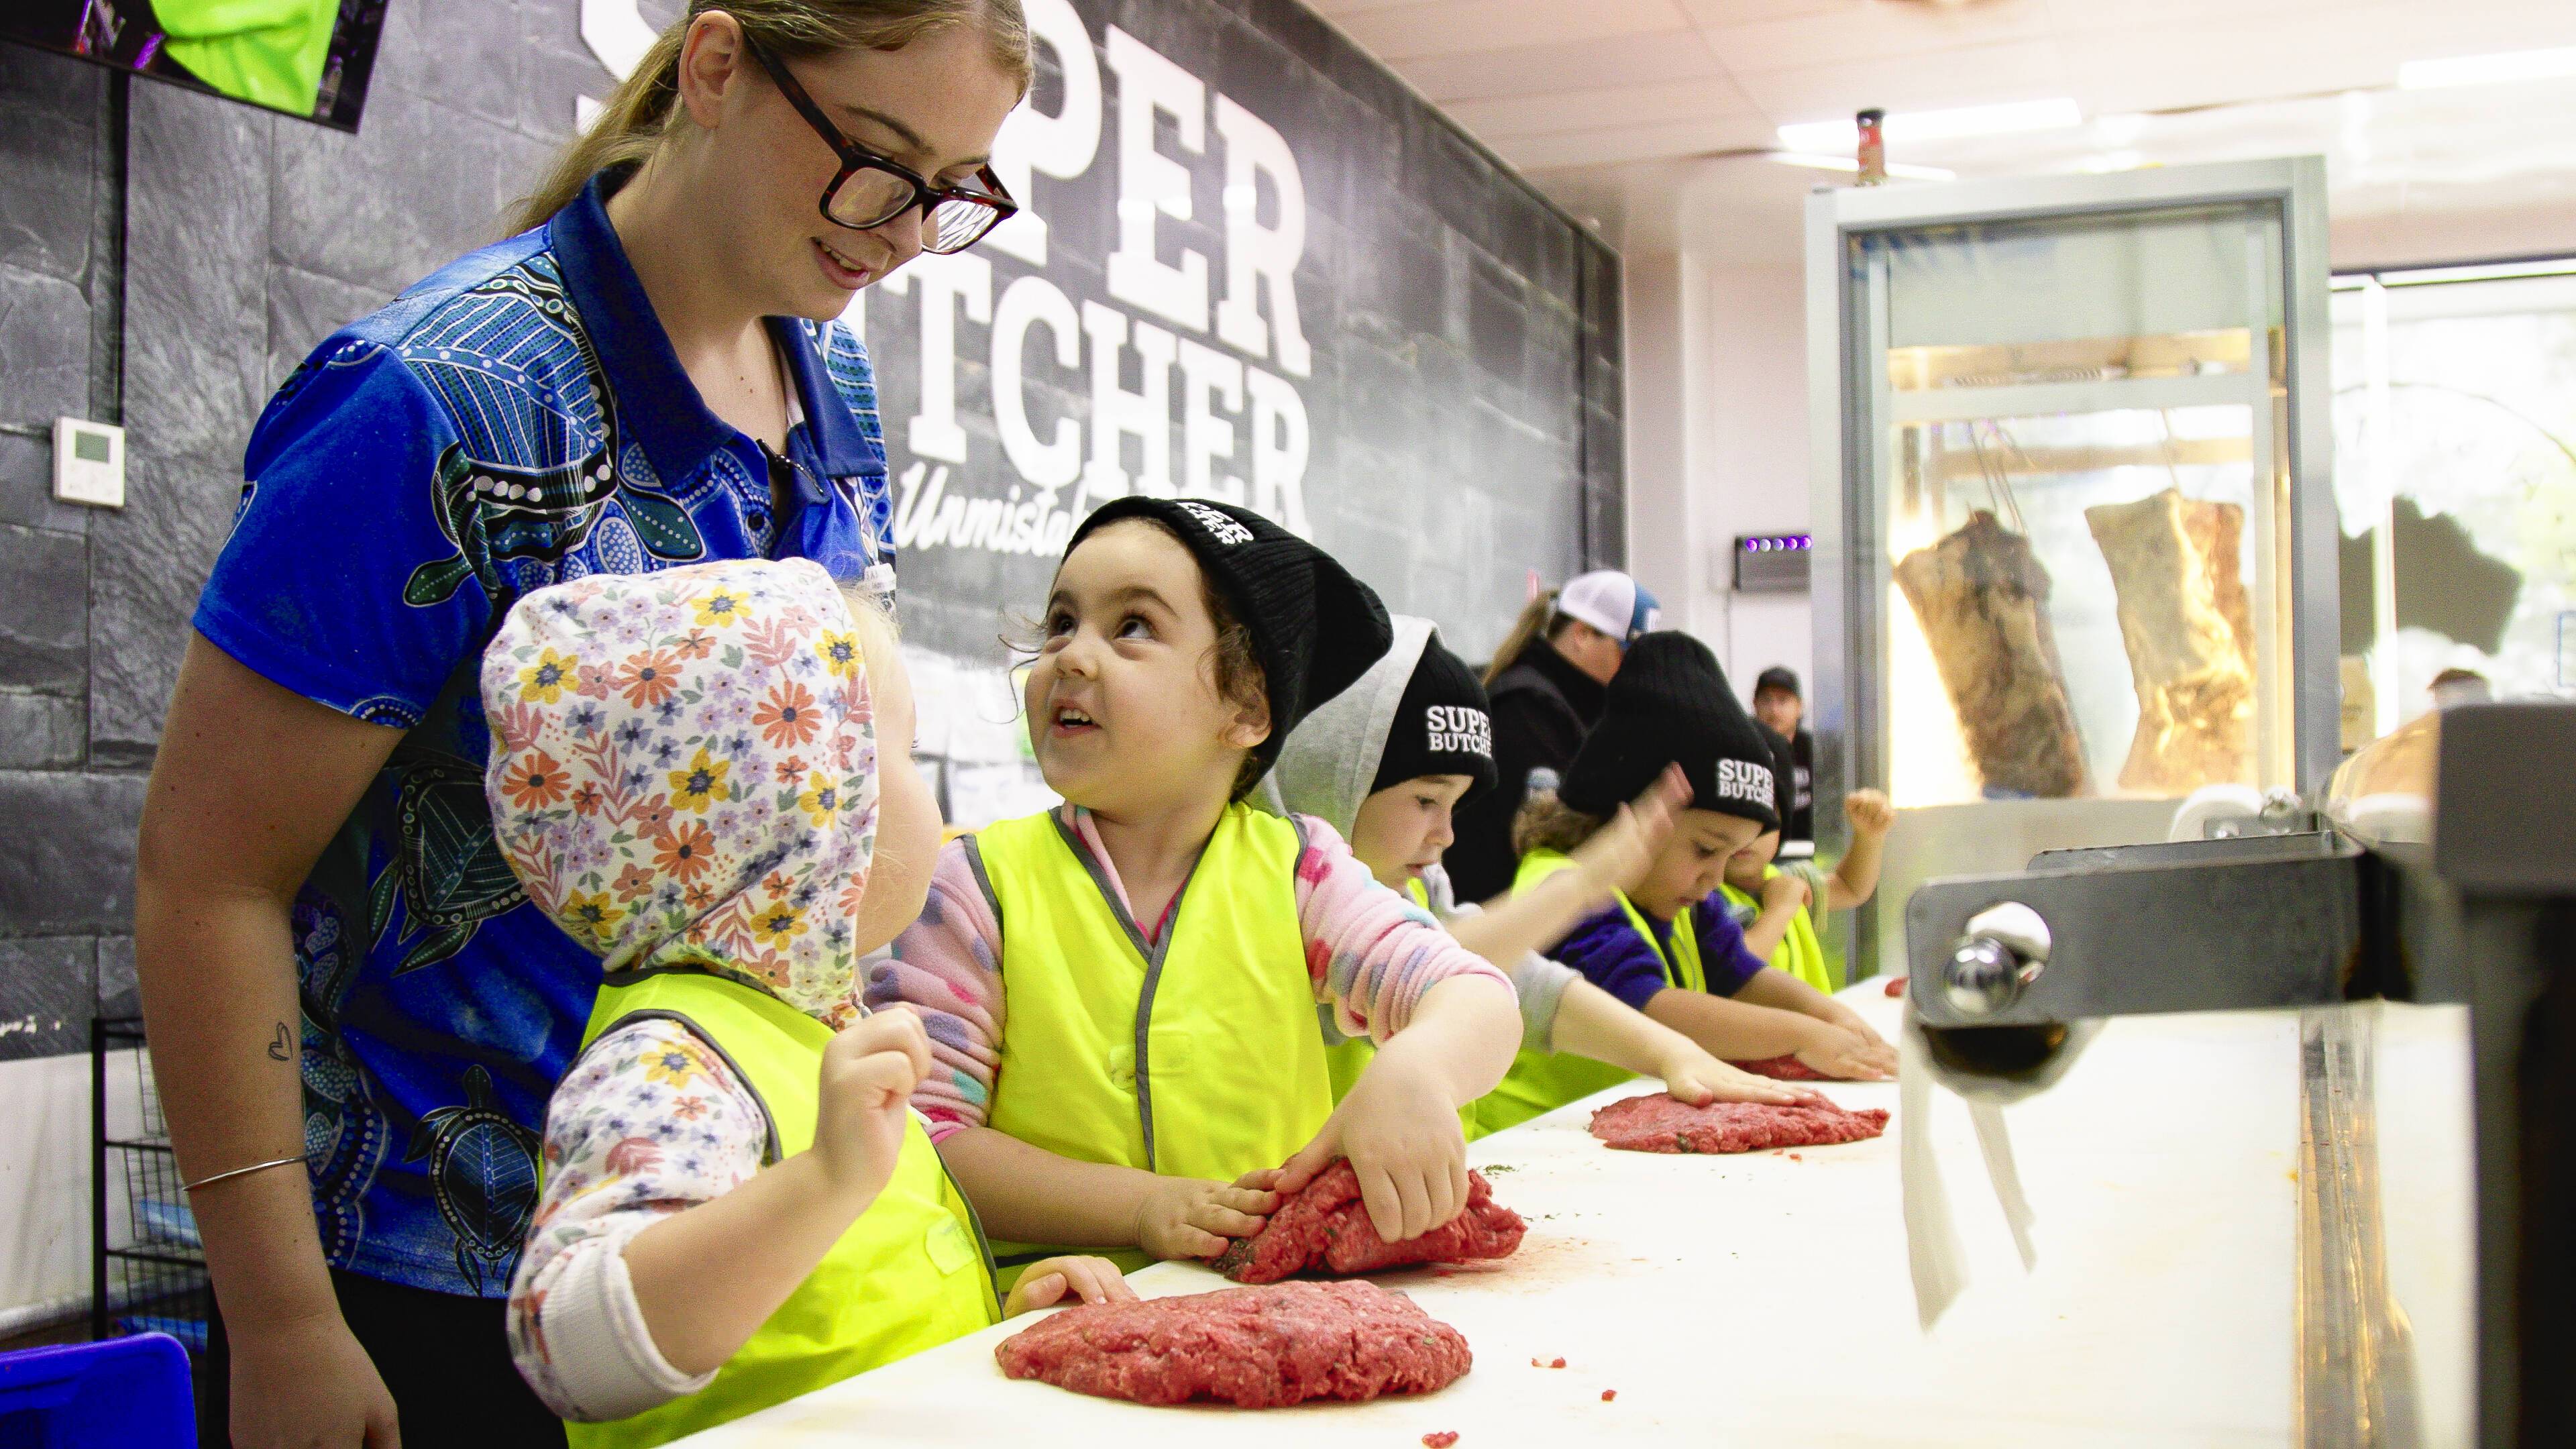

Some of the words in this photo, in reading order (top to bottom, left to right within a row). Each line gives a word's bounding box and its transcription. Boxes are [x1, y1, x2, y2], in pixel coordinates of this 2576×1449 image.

[839, 248, 1313, 541] TCHER
[1427, 706, 1491, 741] SUPE
[1718, 757, 1774, 793] SUPE
